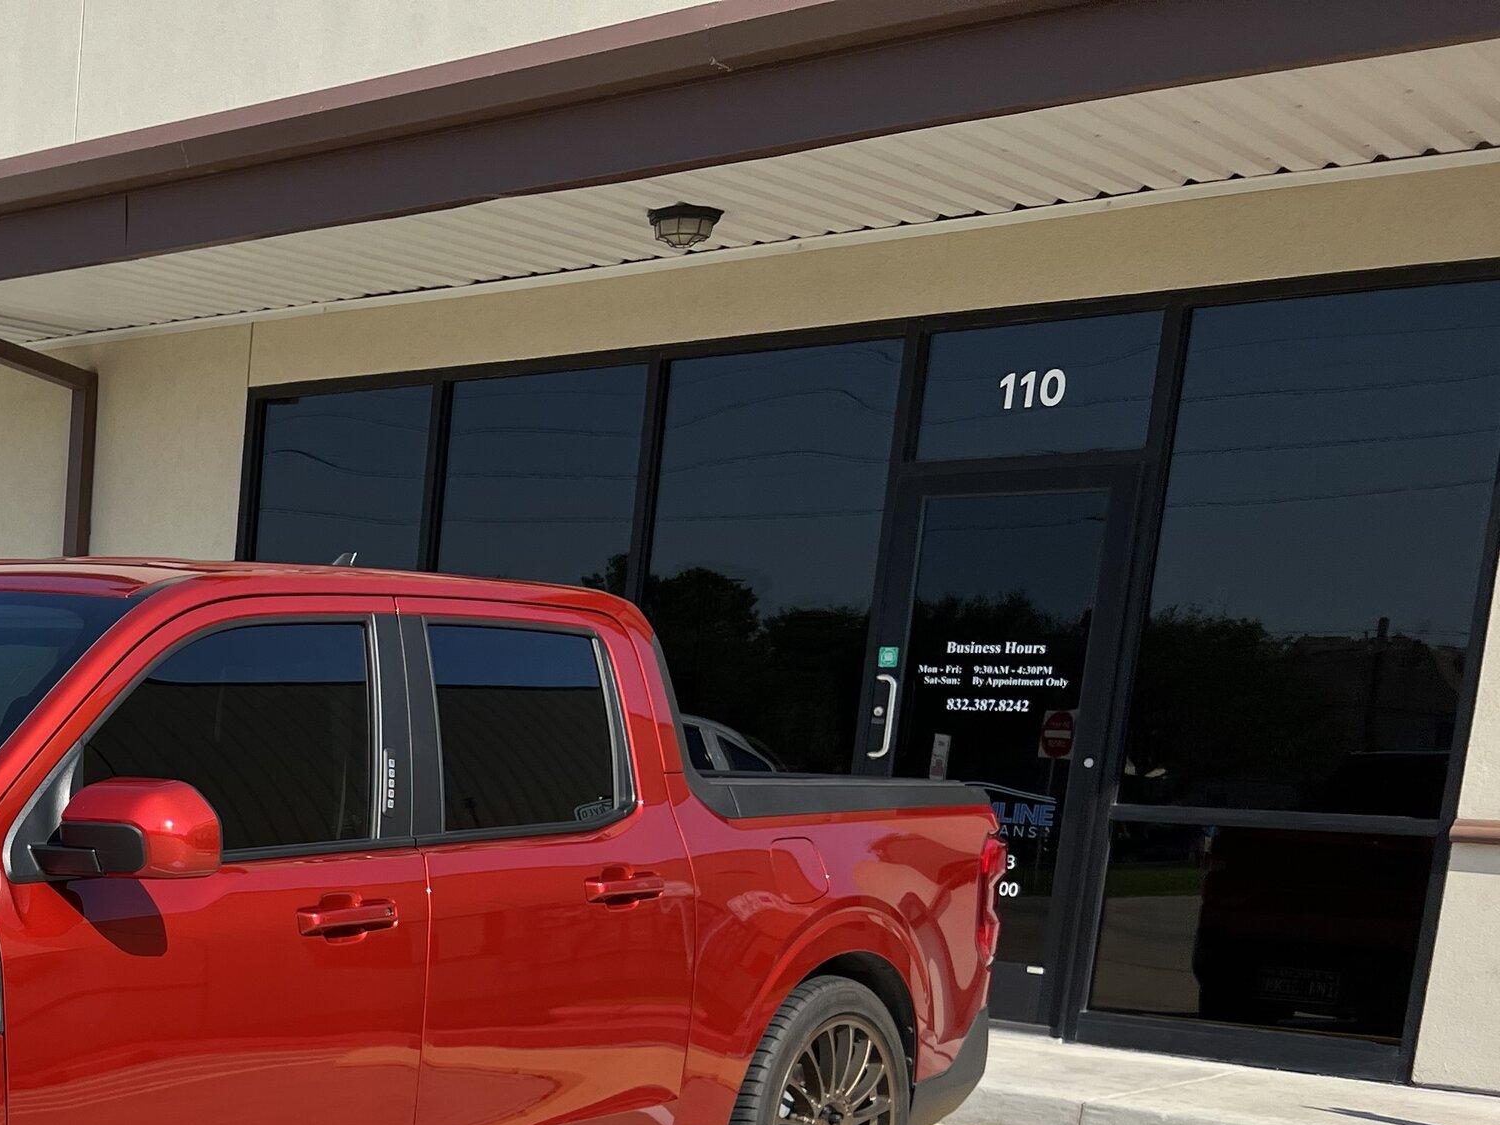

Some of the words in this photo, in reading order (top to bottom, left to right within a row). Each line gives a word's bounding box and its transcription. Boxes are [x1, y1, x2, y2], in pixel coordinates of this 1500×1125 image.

[999, 368, 1067, 410] 110
[946, 641, 1001, 655] Business
[1005, 641, 1047, 655] Hours
[918, 664, 937, 674] Mon
[972, 676, 984, 687] By
[986, 677, 1044, 687] Appointment
[1045, 678, 1069, 689] Only
[946, 698, 1030, 713] 832.387.8242
[991, 802, 1056, 827] LINE
